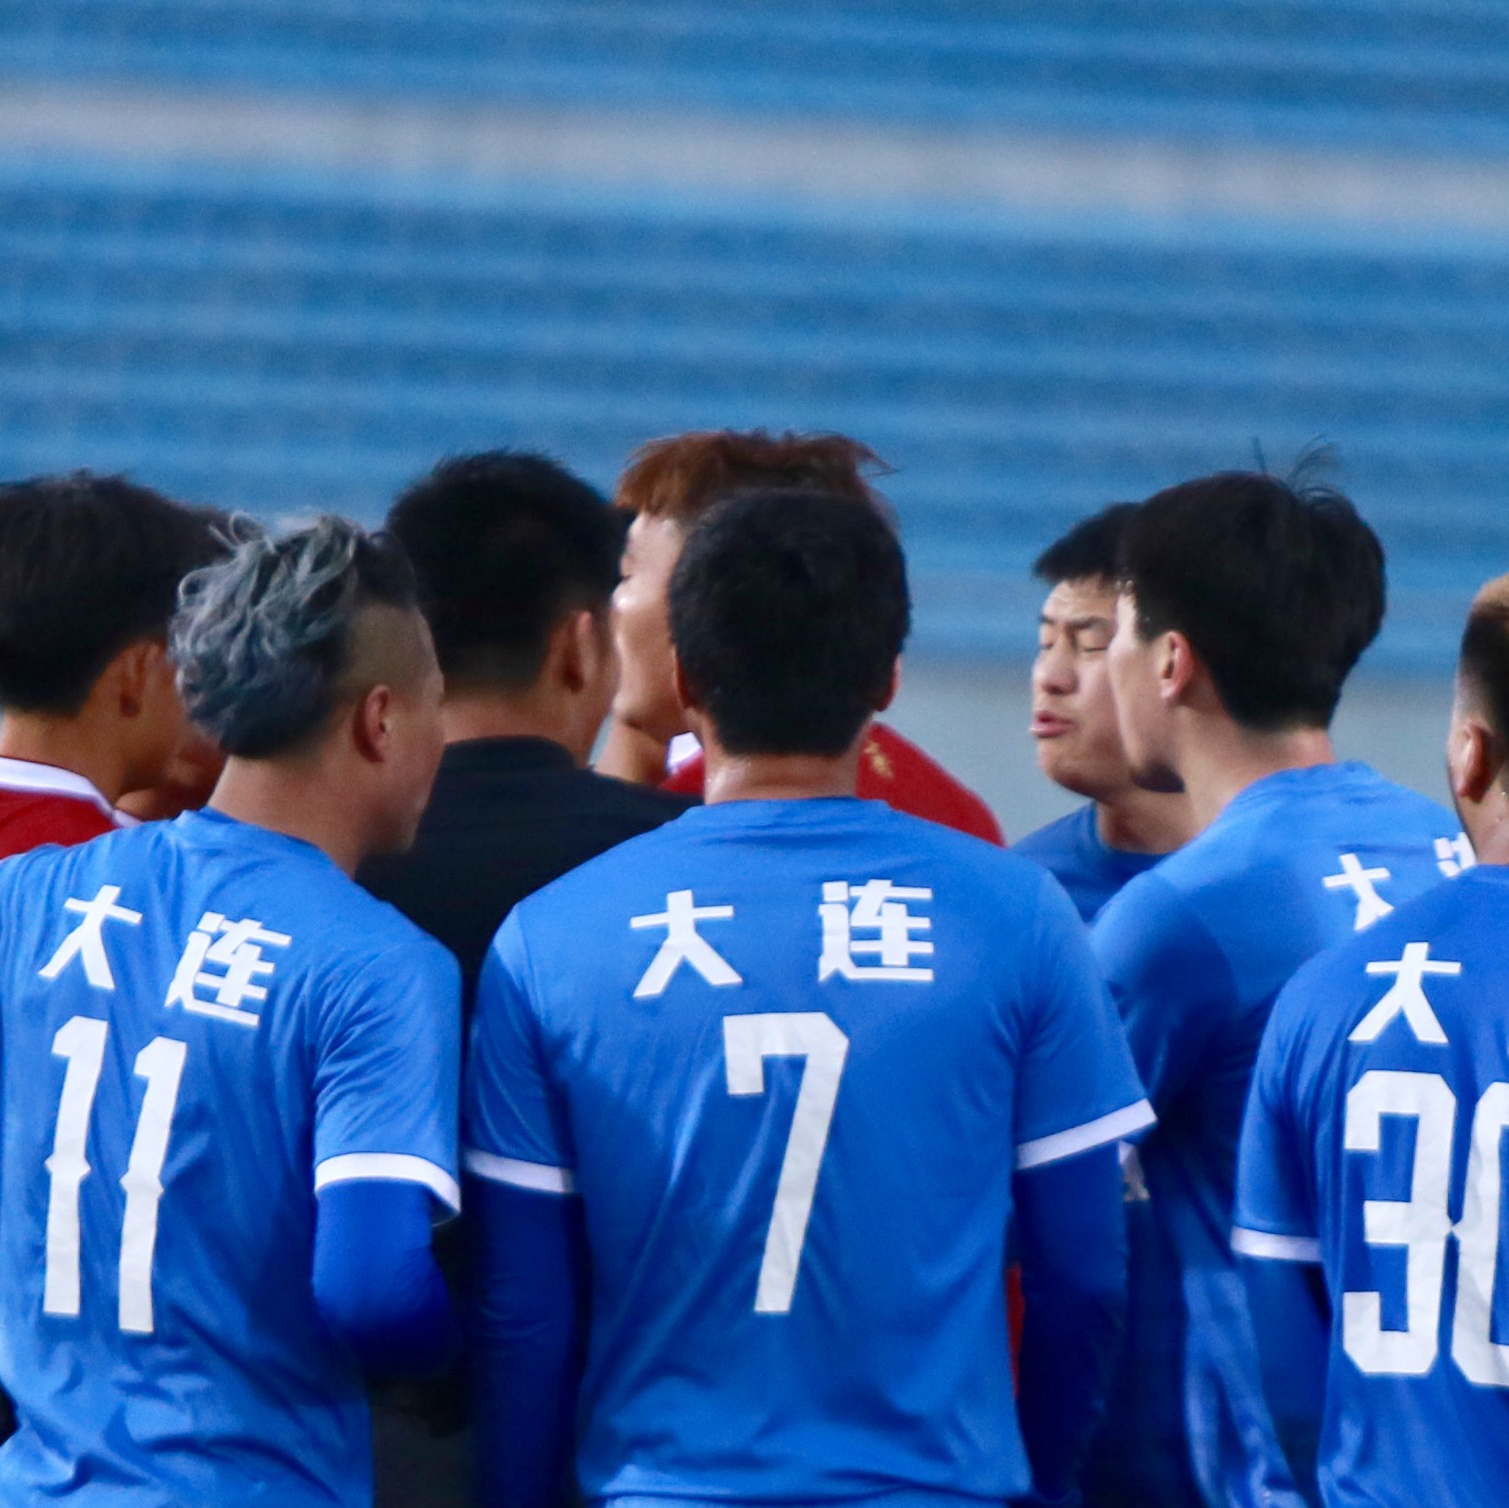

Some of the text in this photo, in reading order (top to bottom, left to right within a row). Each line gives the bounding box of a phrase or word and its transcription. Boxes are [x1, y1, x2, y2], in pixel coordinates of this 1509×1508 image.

[38, 883, 292, 1028] 大连
[629, 878, 935, 998] 大连
[42, 1015, 188, 1335] 11
[722, 1011, 850, 1316] 7
